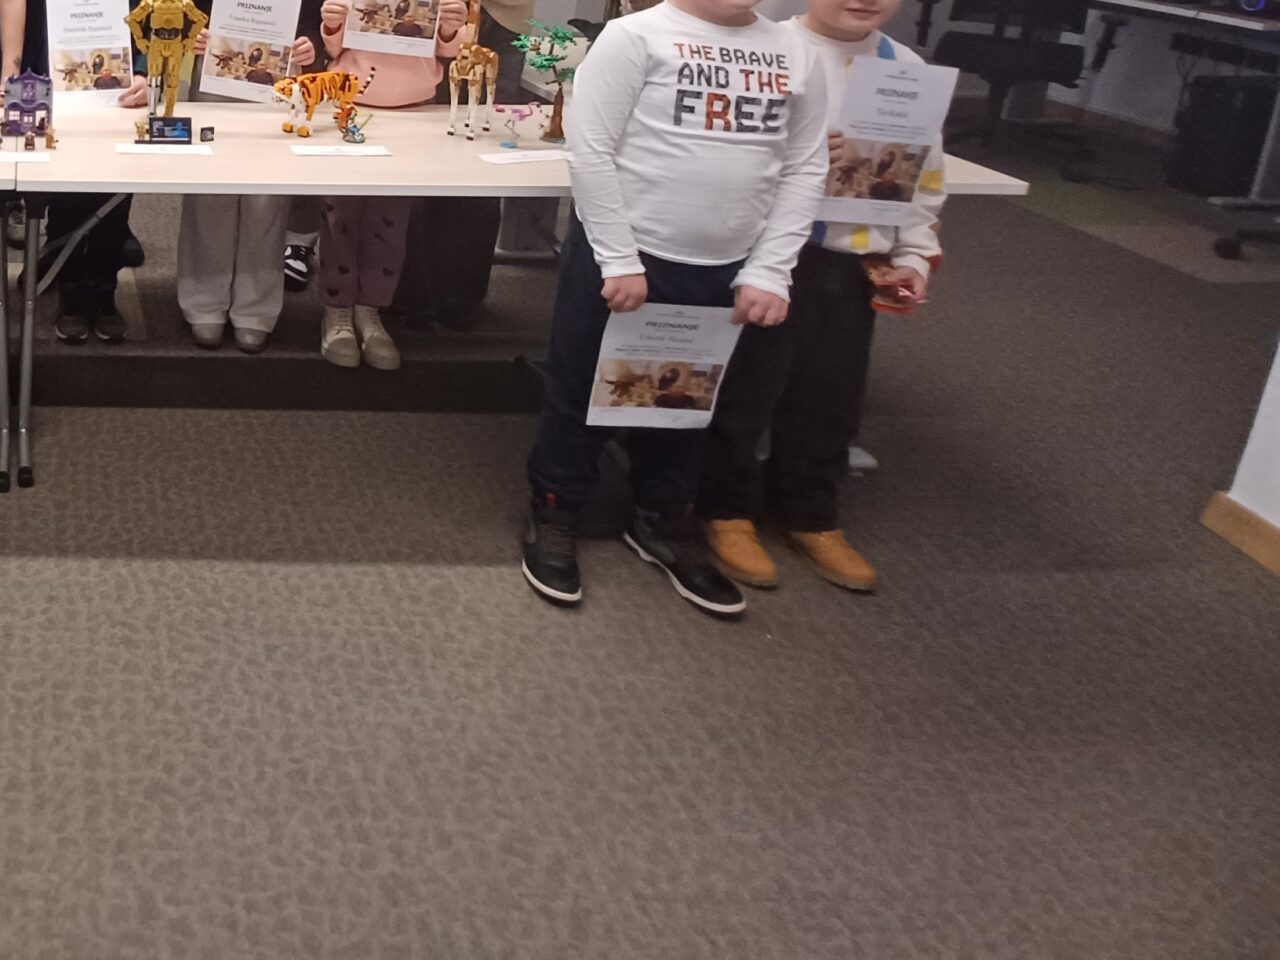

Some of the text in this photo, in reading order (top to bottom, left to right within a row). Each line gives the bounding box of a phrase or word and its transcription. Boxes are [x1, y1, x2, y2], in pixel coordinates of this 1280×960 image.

[237, 1, 272, 13] PRIZNANJE
[673, 43, 790, 70] THE BRAVE
[677, 61, 793, 96] AND THE
[673, 89, 786, 133] FREE
